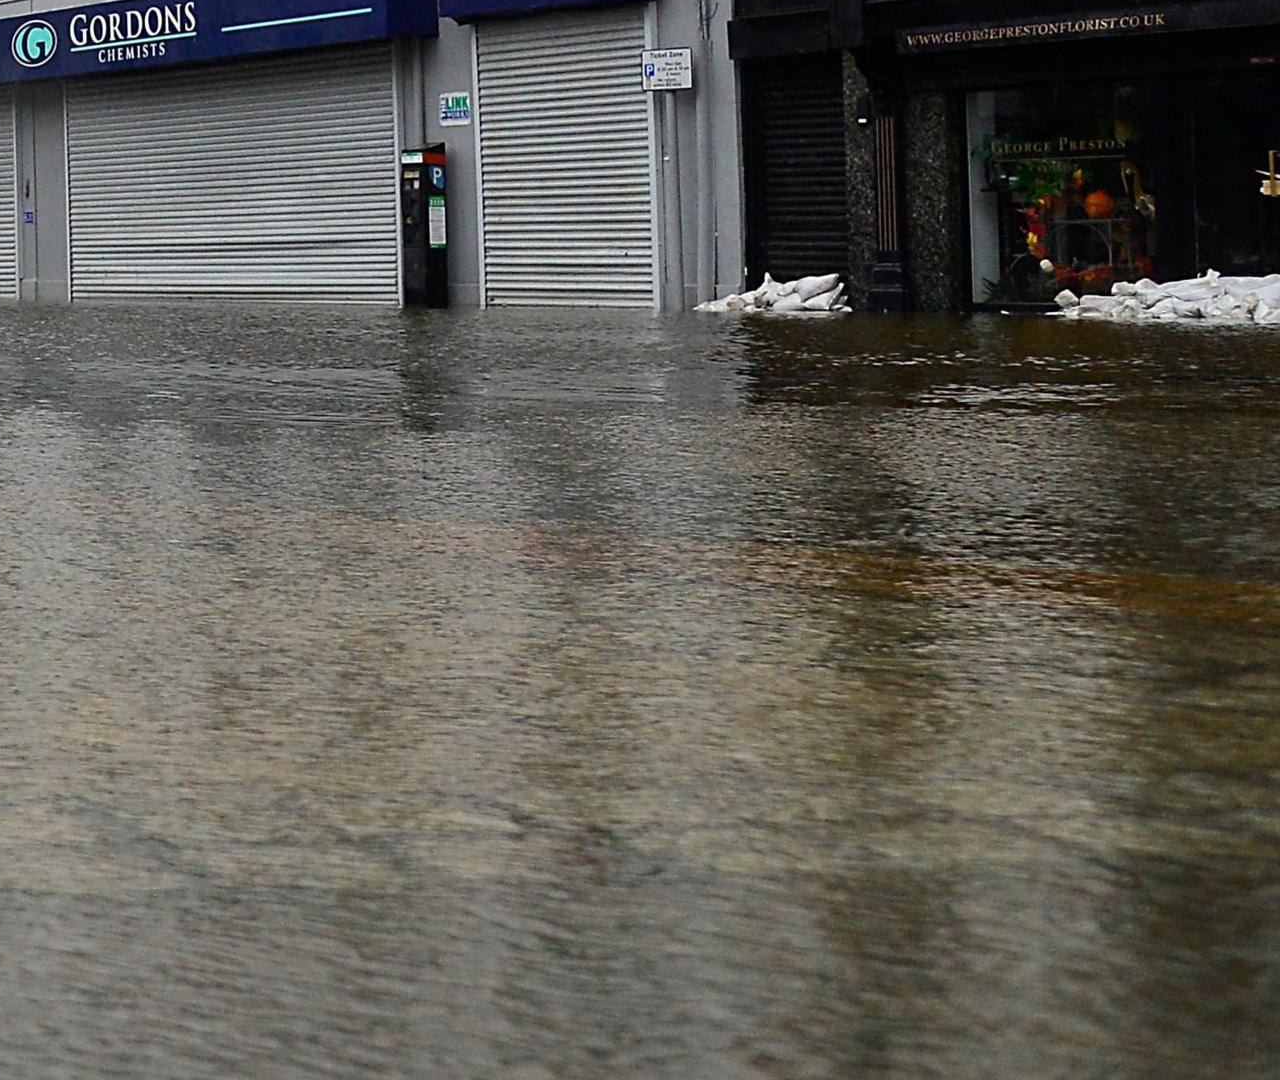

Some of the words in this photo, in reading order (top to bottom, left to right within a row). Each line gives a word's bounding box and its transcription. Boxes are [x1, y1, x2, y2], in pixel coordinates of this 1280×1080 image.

[70, 1, 196, 47] GORDONS
[906, 13, 1166, 48] WWW.GEORGEPRESTONFLORIST.CO.UK
[98, 42, 166, 63] CHEMISTS
[446, 95, 469, 110] LINK
[991, 141, 1053, 154] GEORGE
[1058, 135, 1127, 152] PRESTON
